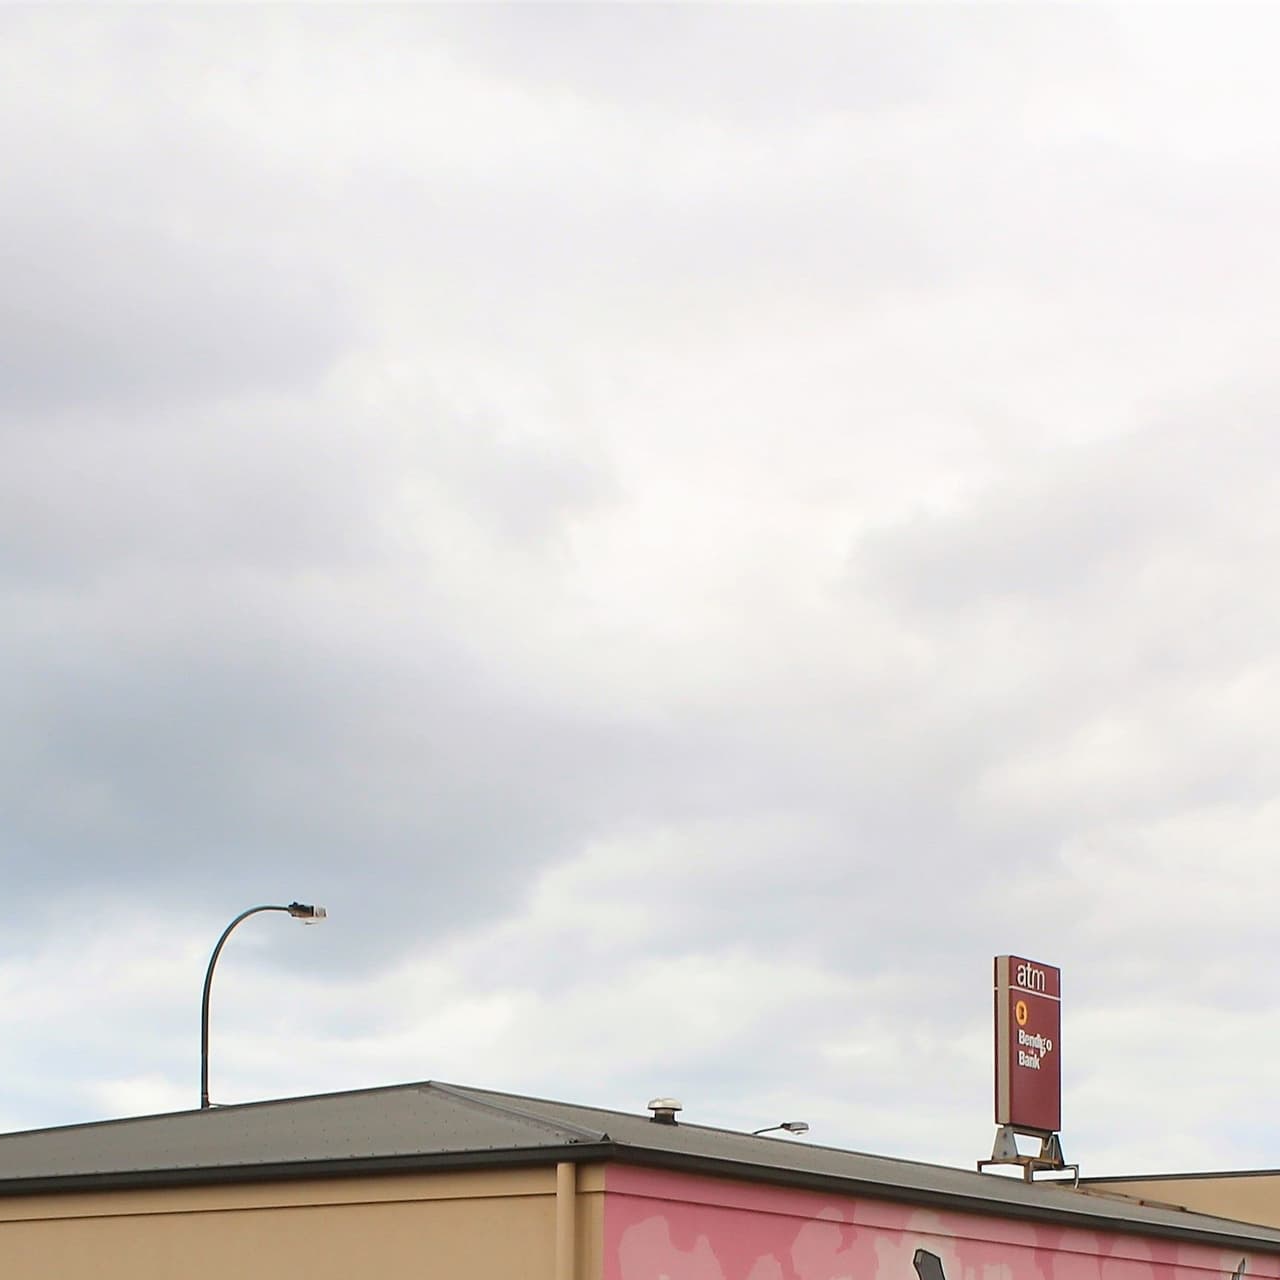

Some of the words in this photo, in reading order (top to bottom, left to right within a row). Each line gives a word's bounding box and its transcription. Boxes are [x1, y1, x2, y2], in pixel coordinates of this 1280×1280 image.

[1017, 962, 1045, 992] atm
[1018, 1029, 1052, 1057] Bendigo
[1018, 1050, 1040, 1069] Bank
